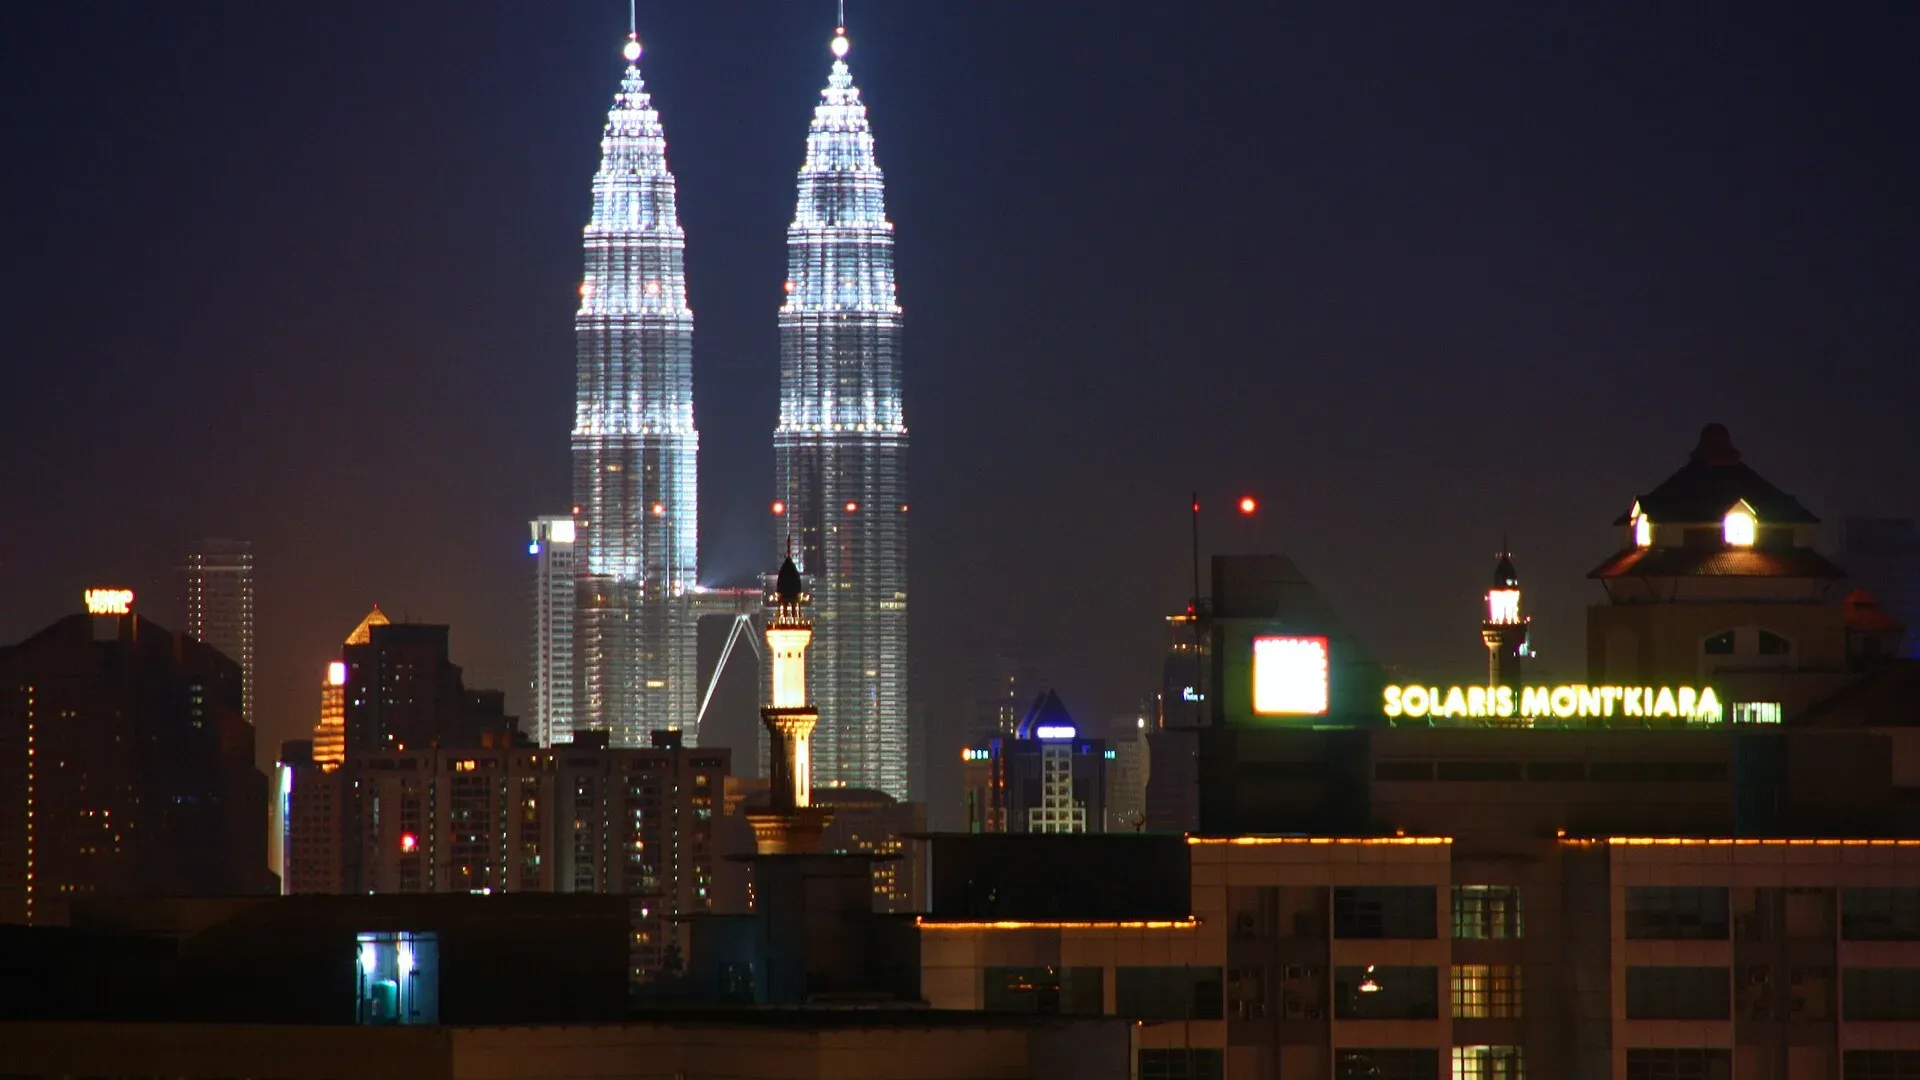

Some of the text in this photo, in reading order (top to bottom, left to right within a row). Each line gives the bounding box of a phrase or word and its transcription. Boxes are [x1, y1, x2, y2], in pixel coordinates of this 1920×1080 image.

[89, 600, 129, 614] HOTEL
[1384, 685, 1721, 717] SOLARIS MONT'KIARA
